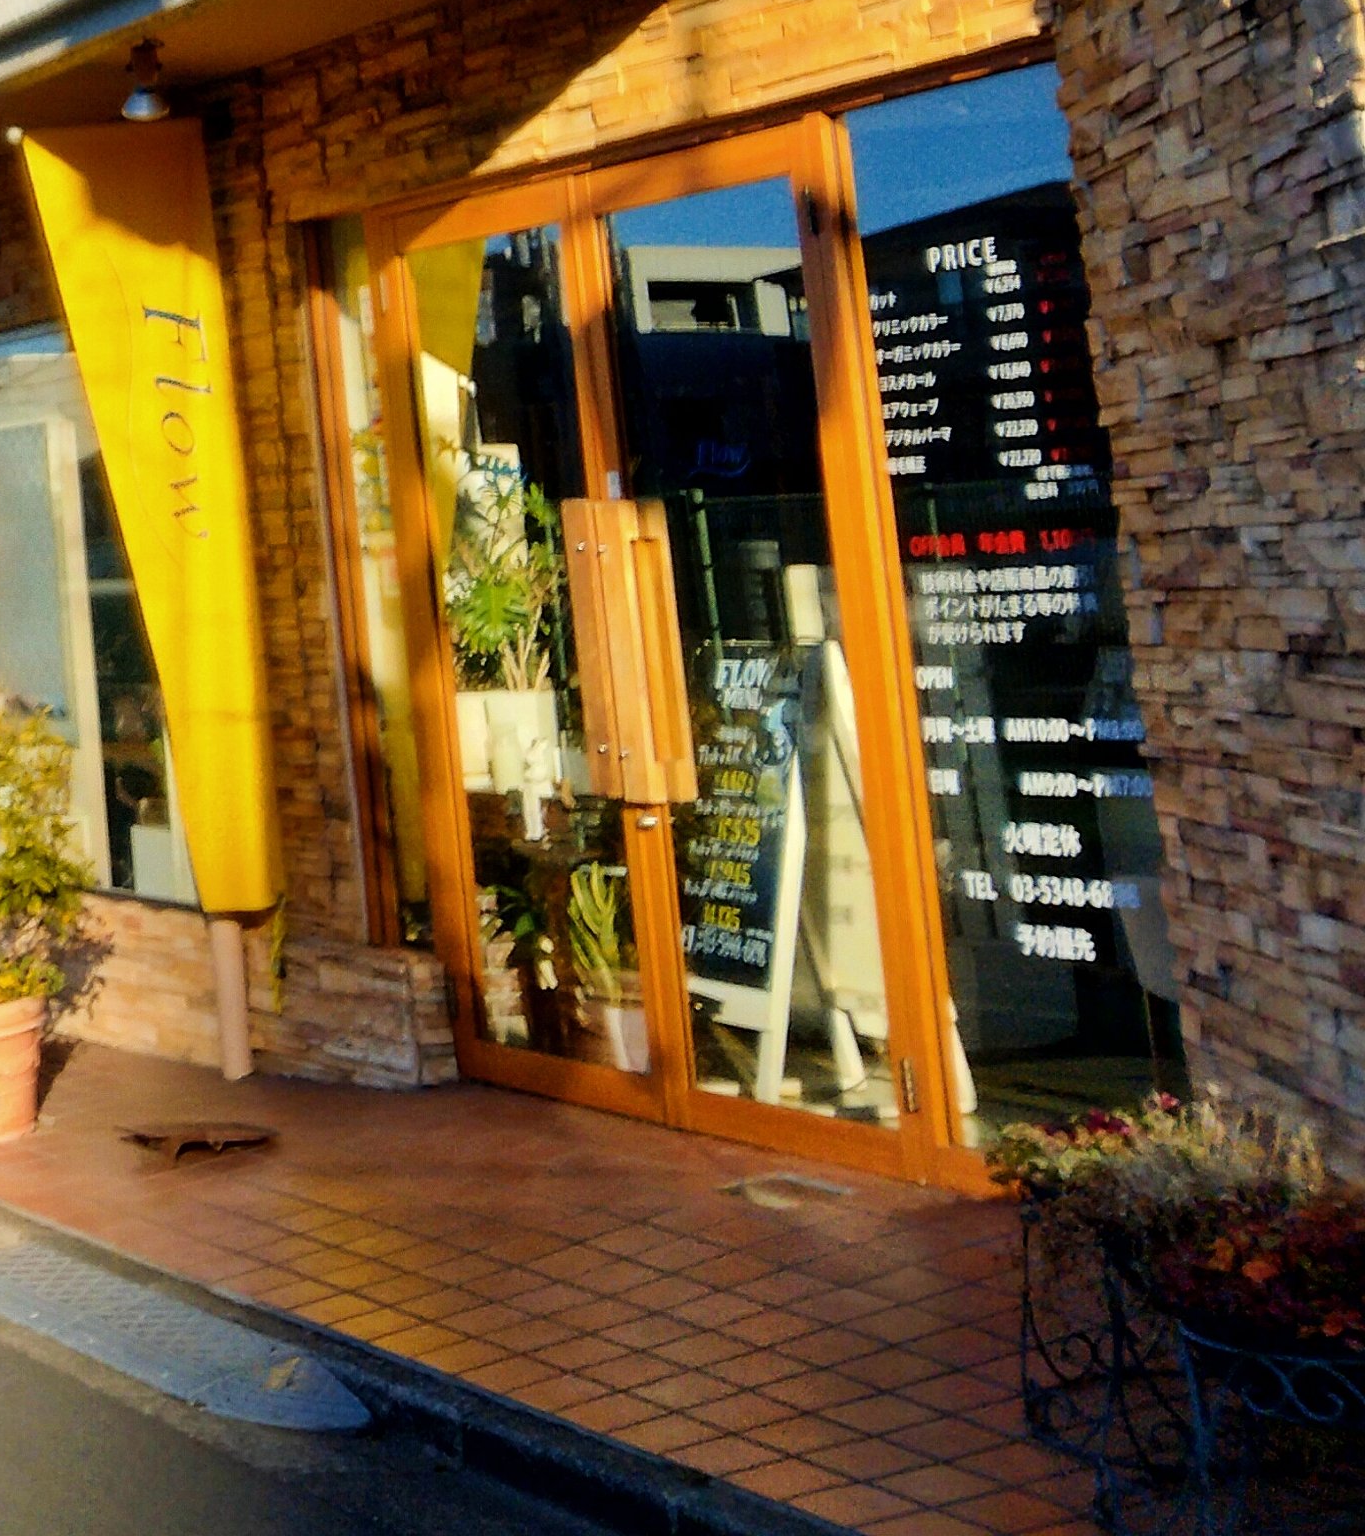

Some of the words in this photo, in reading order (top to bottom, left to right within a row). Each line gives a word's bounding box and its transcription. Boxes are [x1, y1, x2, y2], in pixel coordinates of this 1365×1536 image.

[925, 236, 998, 273] PRICE
[142, 302, 213, 538] Flow
[915, 666, 953, 690] OPEN
